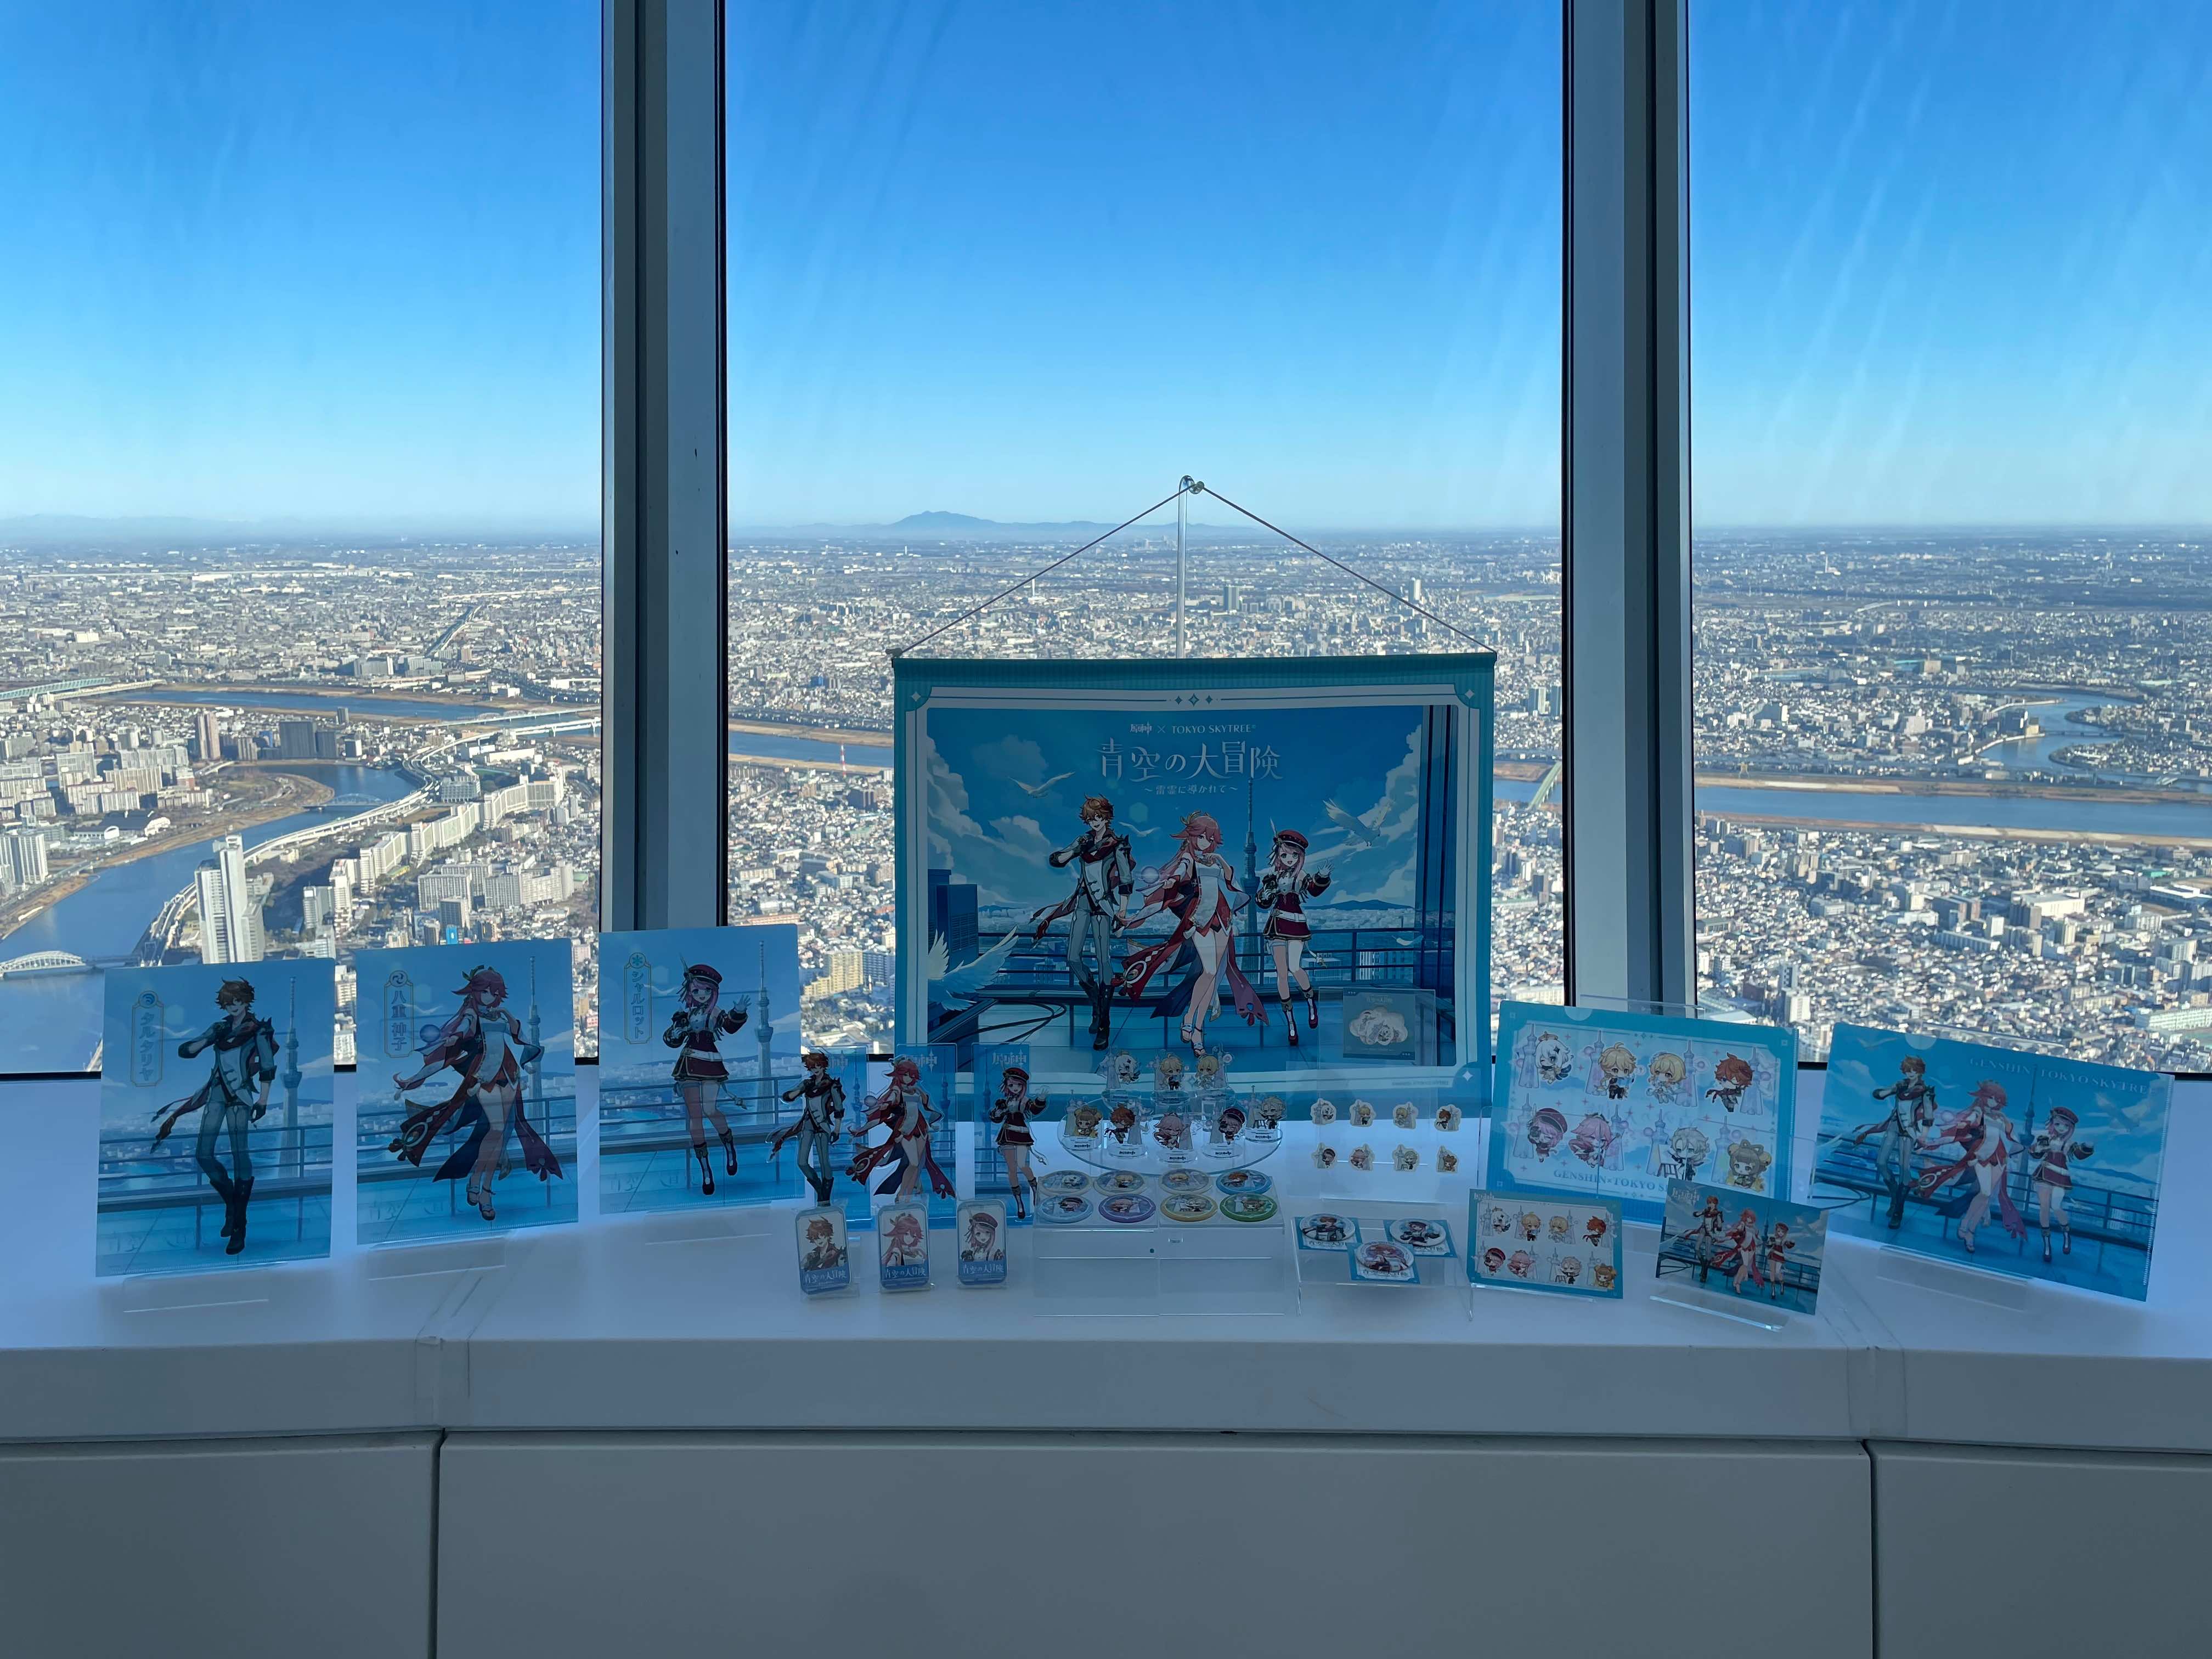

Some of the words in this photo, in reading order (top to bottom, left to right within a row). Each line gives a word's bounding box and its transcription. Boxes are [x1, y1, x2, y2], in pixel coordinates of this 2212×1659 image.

[1172, 725, 1205, 734] TOKYO
[1093, 737, 1284, 782] 青空の大冒険
[391, 990, 407, 1051] 八重神子
[1970, 1058, 2031, 1075] GENSHIN
[2040, 1069, 2089, 1084] TOKYO
